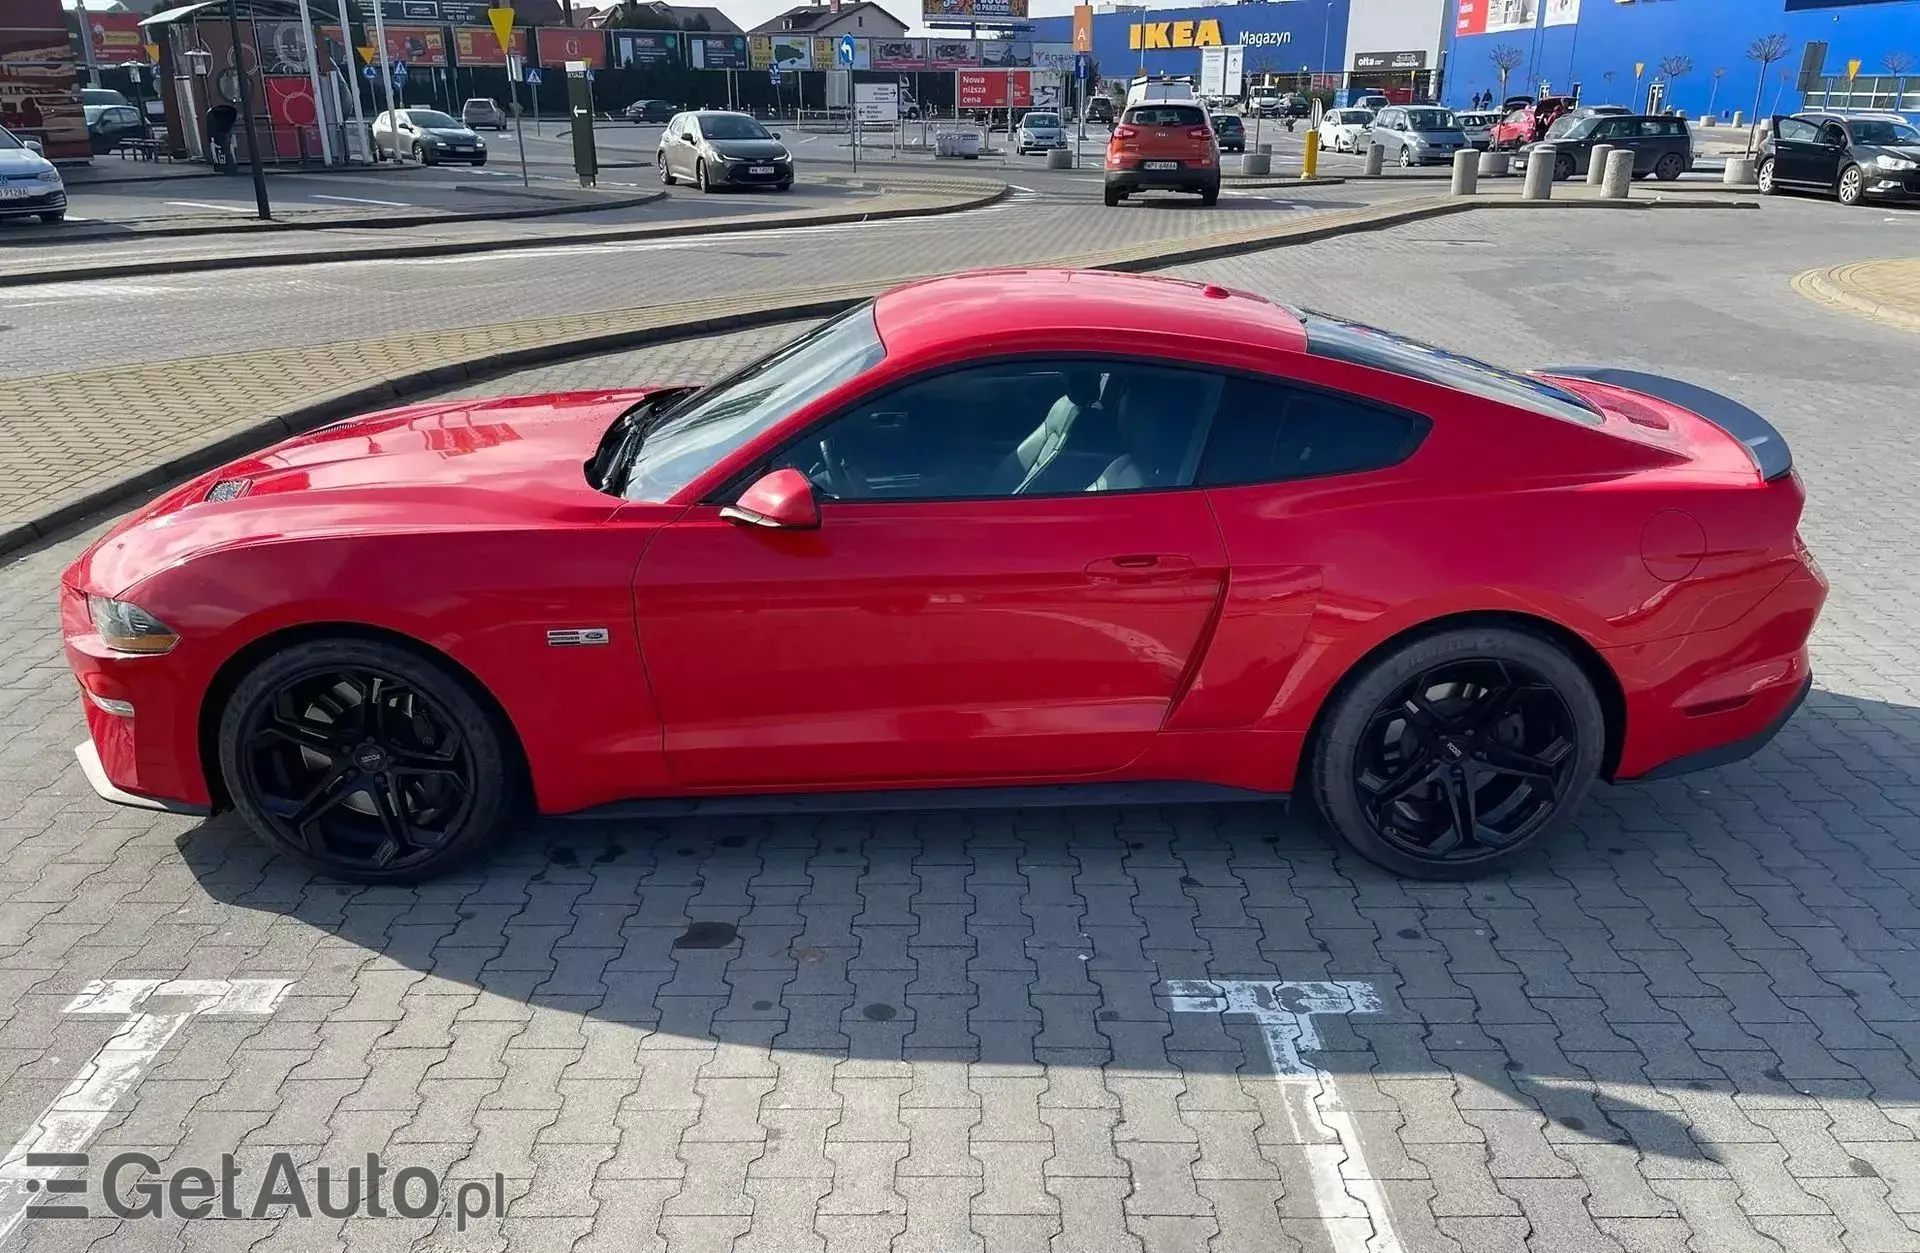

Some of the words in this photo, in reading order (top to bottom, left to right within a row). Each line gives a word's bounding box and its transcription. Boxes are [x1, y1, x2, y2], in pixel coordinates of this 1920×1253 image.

[1077, 28, 1086, 41] A
[1129, 19, 1222, 50] IKEA
[1240, 31, 1291, 47] Magazyn
[963, 76, 985, 84] Nowa
[963, 86, 986, 94] niższa
